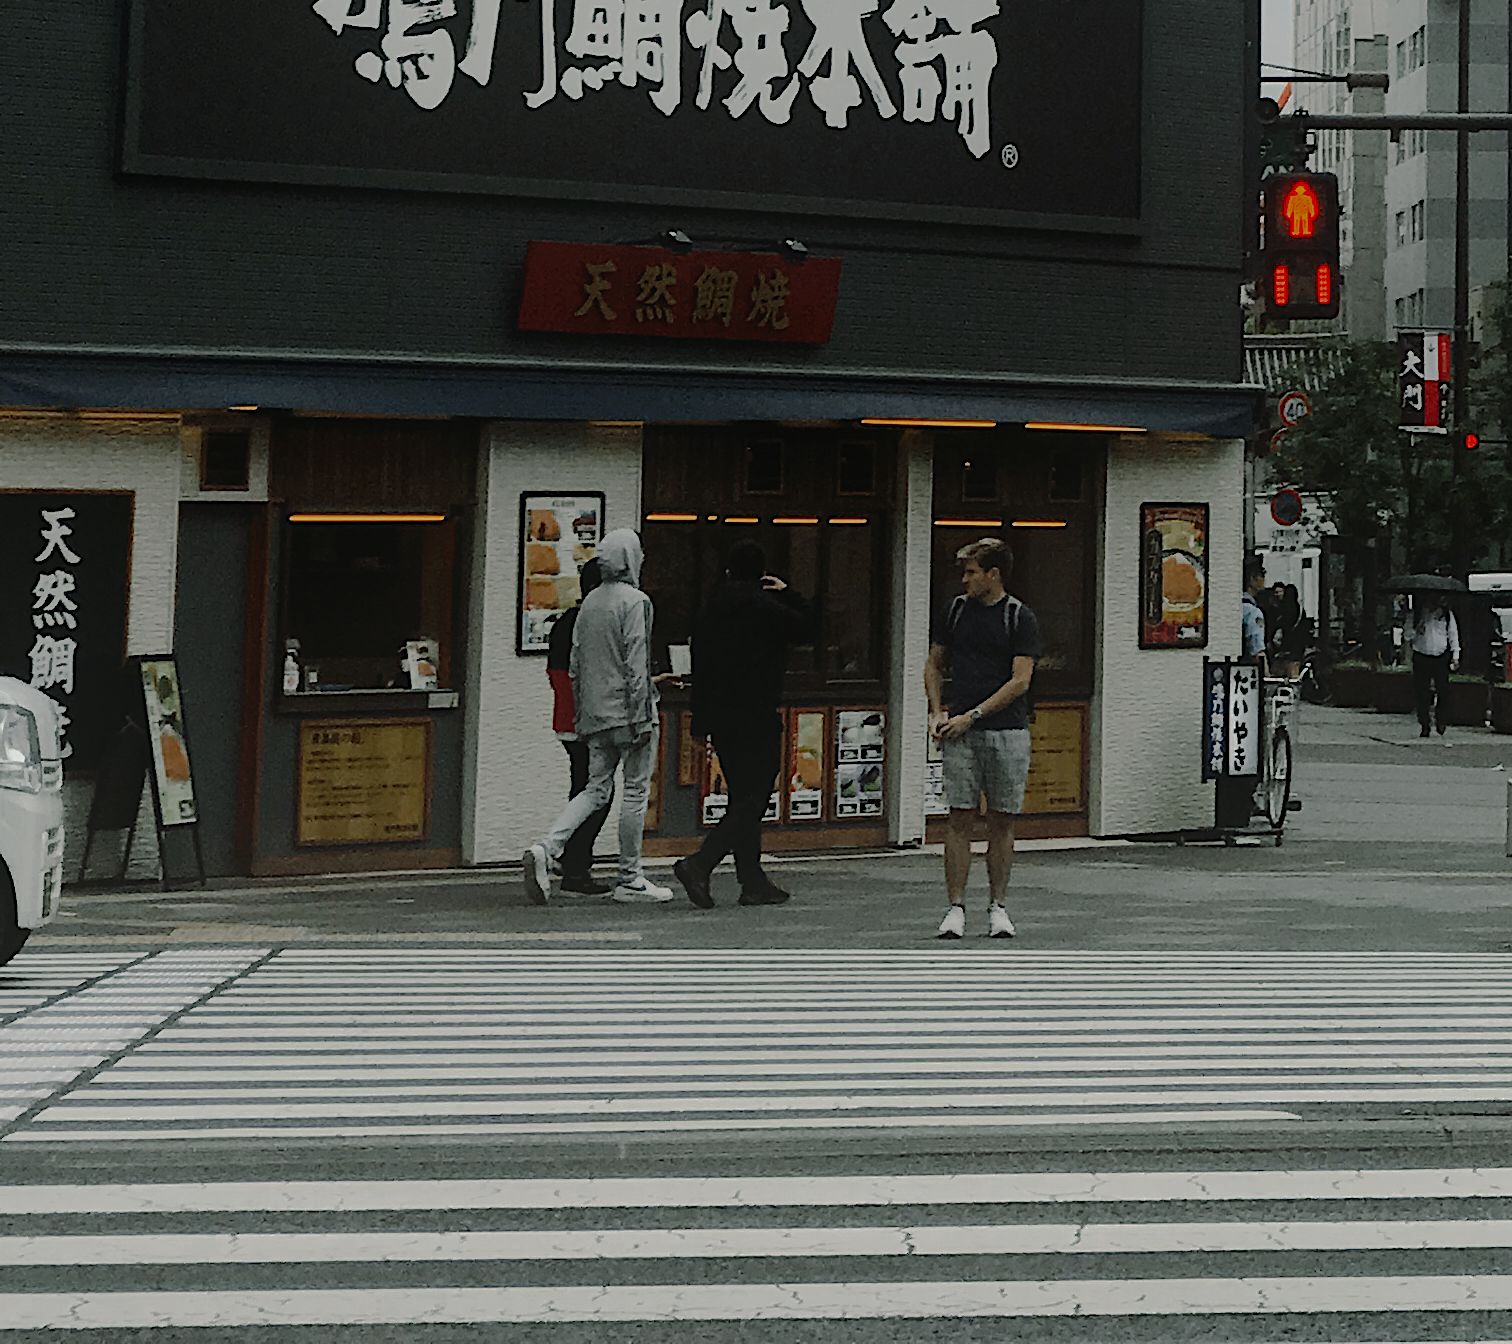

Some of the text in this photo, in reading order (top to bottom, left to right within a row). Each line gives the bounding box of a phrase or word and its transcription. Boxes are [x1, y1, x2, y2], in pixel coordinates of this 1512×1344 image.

[574, 258, 792, 330] 天然鯛焼
[1399, 349, 1425, 411] 大門
[1233, 670, 1249, 772] たいやき
